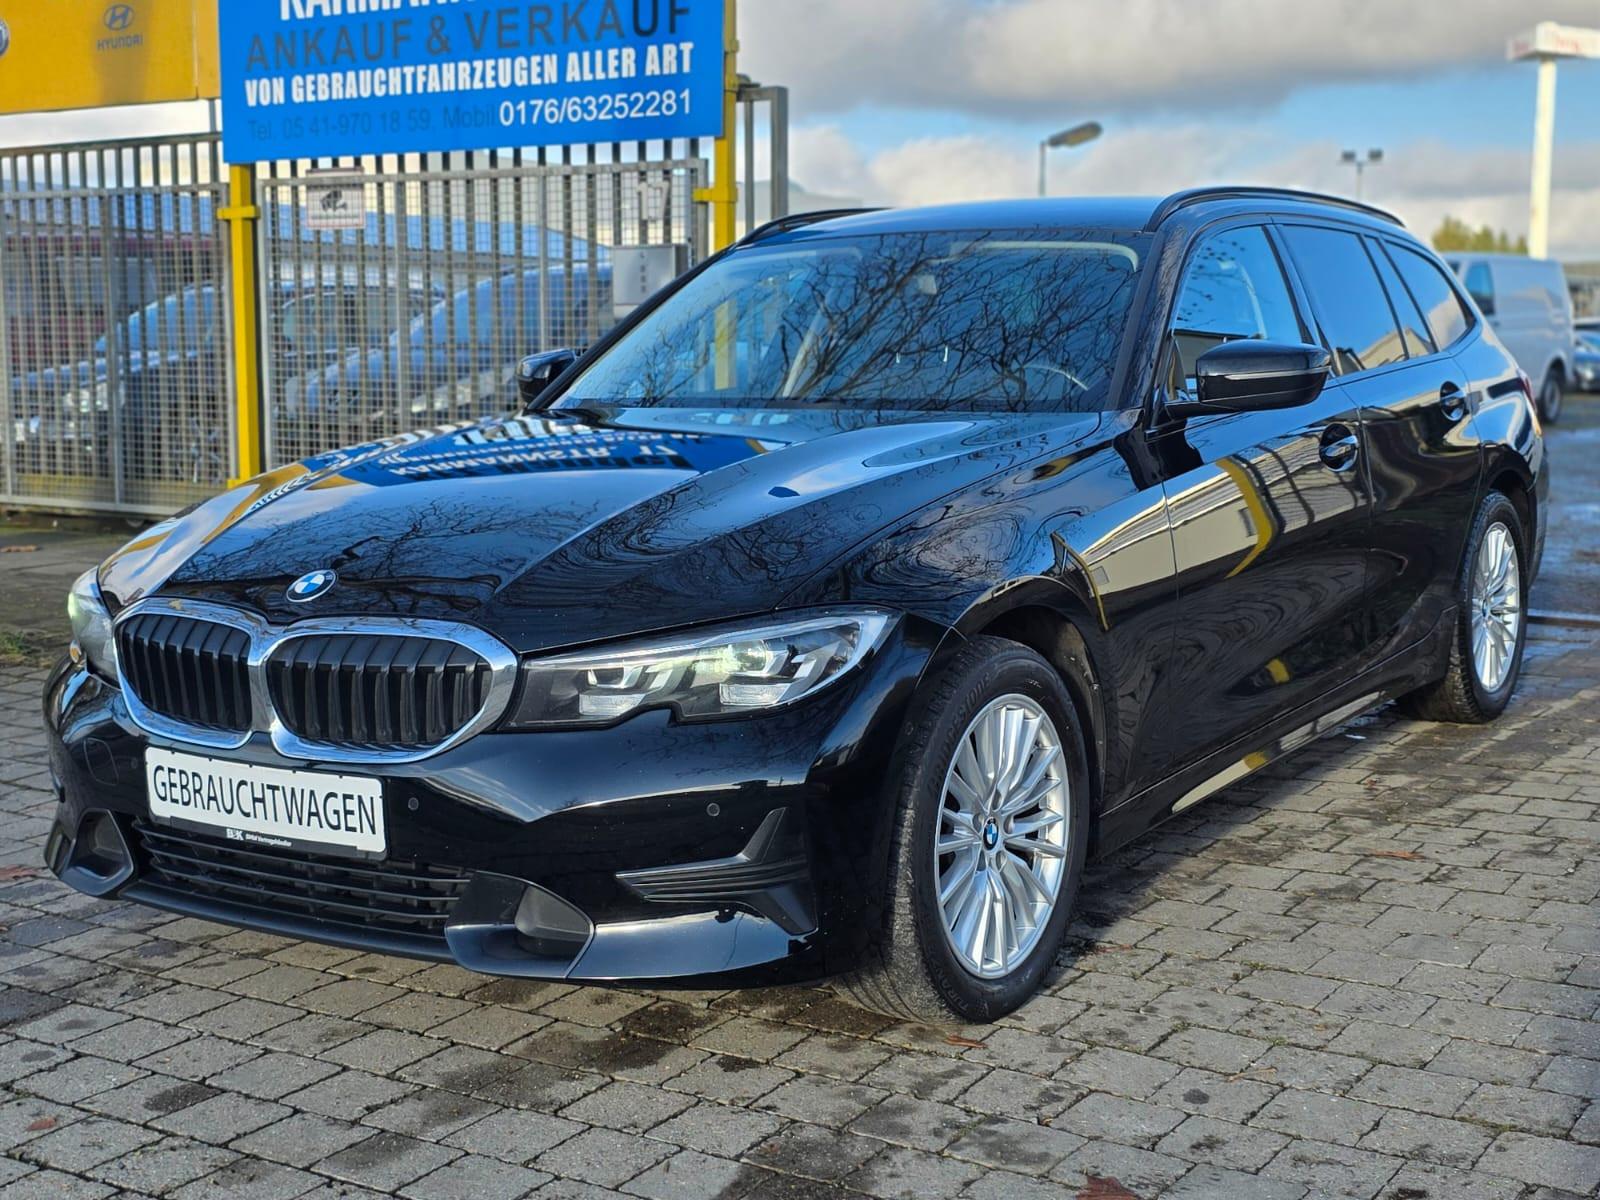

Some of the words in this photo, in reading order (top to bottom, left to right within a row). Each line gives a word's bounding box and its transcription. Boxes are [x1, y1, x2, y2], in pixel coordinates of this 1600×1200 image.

[97, 35, 144, 50] HYUNDAI
[245, 18, 413, 73] ANKAUF
[425, 15, 452, 57] &
[463, 0, 690, 50] VERKAUF
[244, 77, 285, 107] VON
[291, 53, 558, 104] GEBRAUCHTFAHRZEUGEN
[565, 47, 637, 83] ALLER
[645, 41, 695, 77] ART
[500, 88, 691, 127] 0176/63252281
[636, 180, 671, 221] 17
[153, 764, 377, 836] GEBRAUCHTWAGEN
